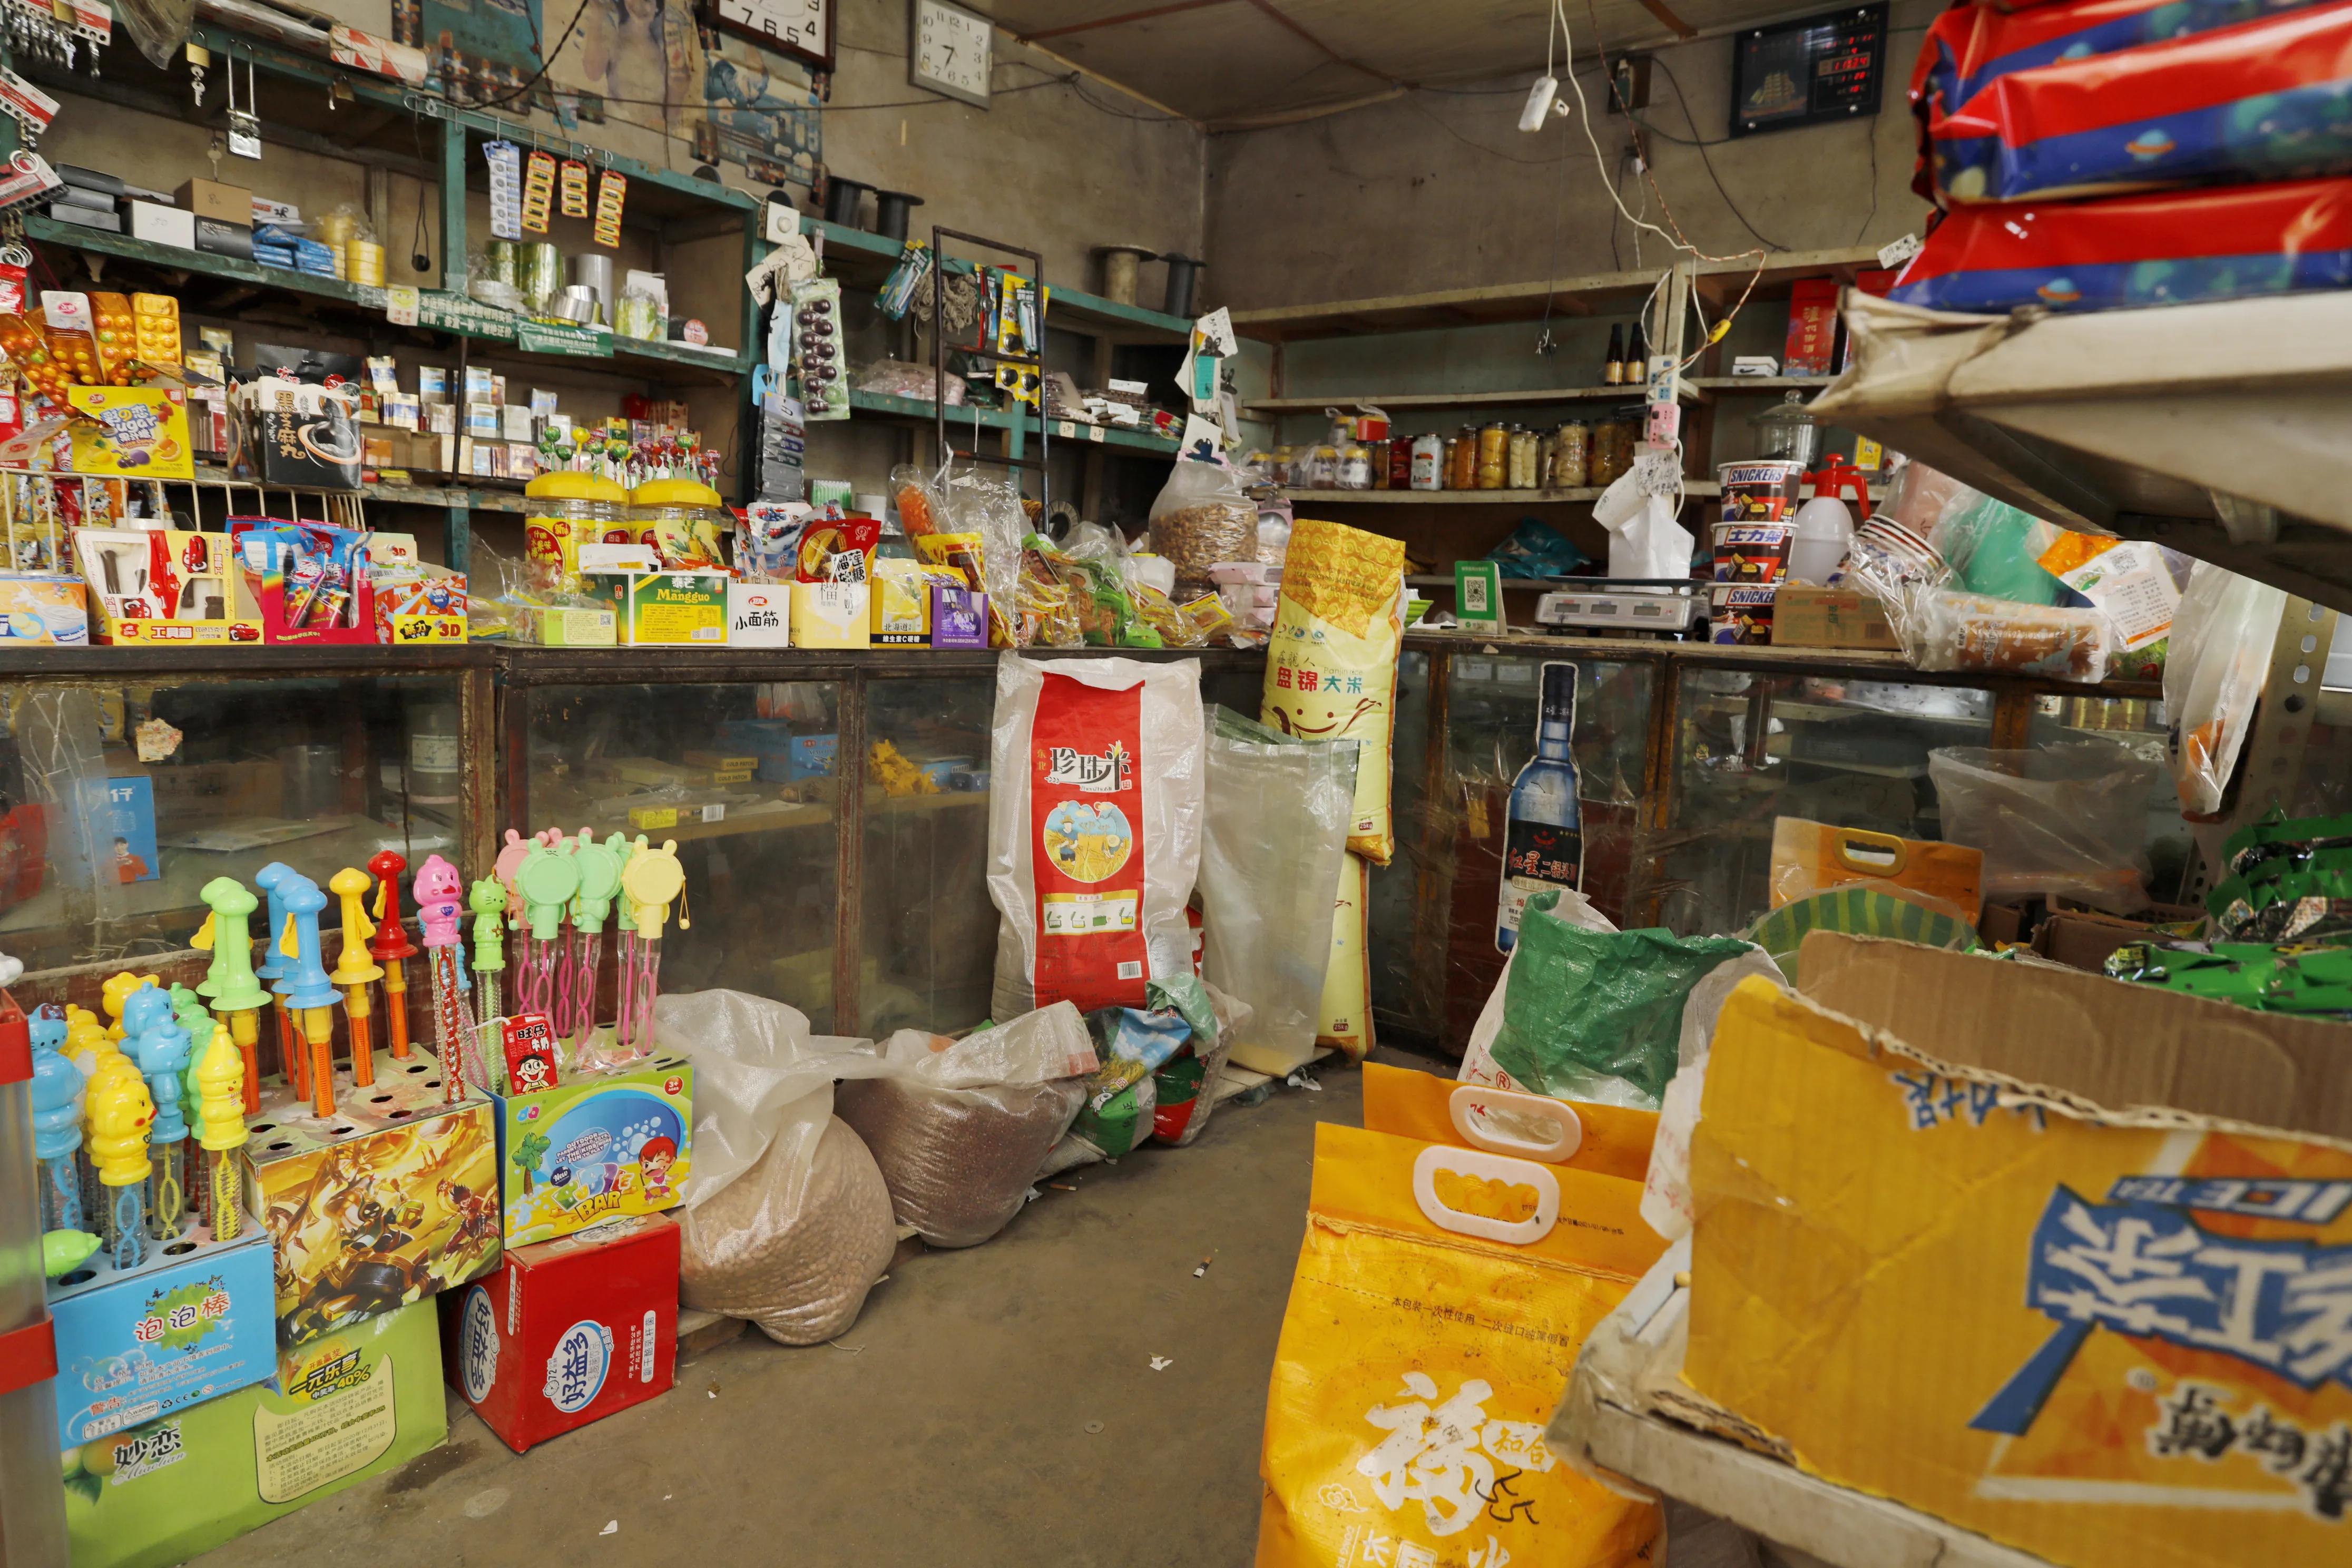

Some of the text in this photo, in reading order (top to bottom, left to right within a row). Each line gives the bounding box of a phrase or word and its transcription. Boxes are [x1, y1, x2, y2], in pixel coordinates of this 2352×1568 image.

[742, 8, 752, 24] 7
[764, 19, 777, 37] 6
[806, 21, 816, 36] 4
[787, 30, 799, 45] 5
[1730, 468, 1783, 483] SNICKERS
[1728, 530, 1783, 543] 士力架
[392, 547, 407, 556] 3D
[656, 589, 710, 603] Mangguo
[1730, 590, 1775, 603] SNICKER
[736, 611, 779, 630] 小面筋
[884, 623, 908, 631] 北海道
[439, 623, 461, 637] 3D
[883, 634, 920, 643] 维生素C硬糖
[1324, 667, 1348, 675] Panjin
[1276, 665, 1363, 694] 盘锦大米
[1050, 740, 1132, 791] 珍珠米
[517, 1024, 547, 1040] 旺仔
[532, 1036, 550, 1052] 牛奶
[566, 1132, 599, 1149] OUTDOOR
[553, 1171, 569, 1183] New
[575, 1190, 621, 1222] BAR
[2109, 1179, 2352, 1222] ICE TEA
[135, 1293, 230, 1341] 泡泡棒
[1391, 1296, 1570, 1348] 本包装一次性使用 二次缝口纯属假冒
[471, 1298, 491, 1391] 好益多
[643, 1316, 654, 1376] 副干酪乳杆菌
[548, 1369, 557, 1380] 72
[561, 1331, 589, 1405] 好益多
[338, 1365, 371, 1390] 40%
[114, 1427, 182, 1471] 妙恋
[112, 1450, 186, 1485] Miaolian
